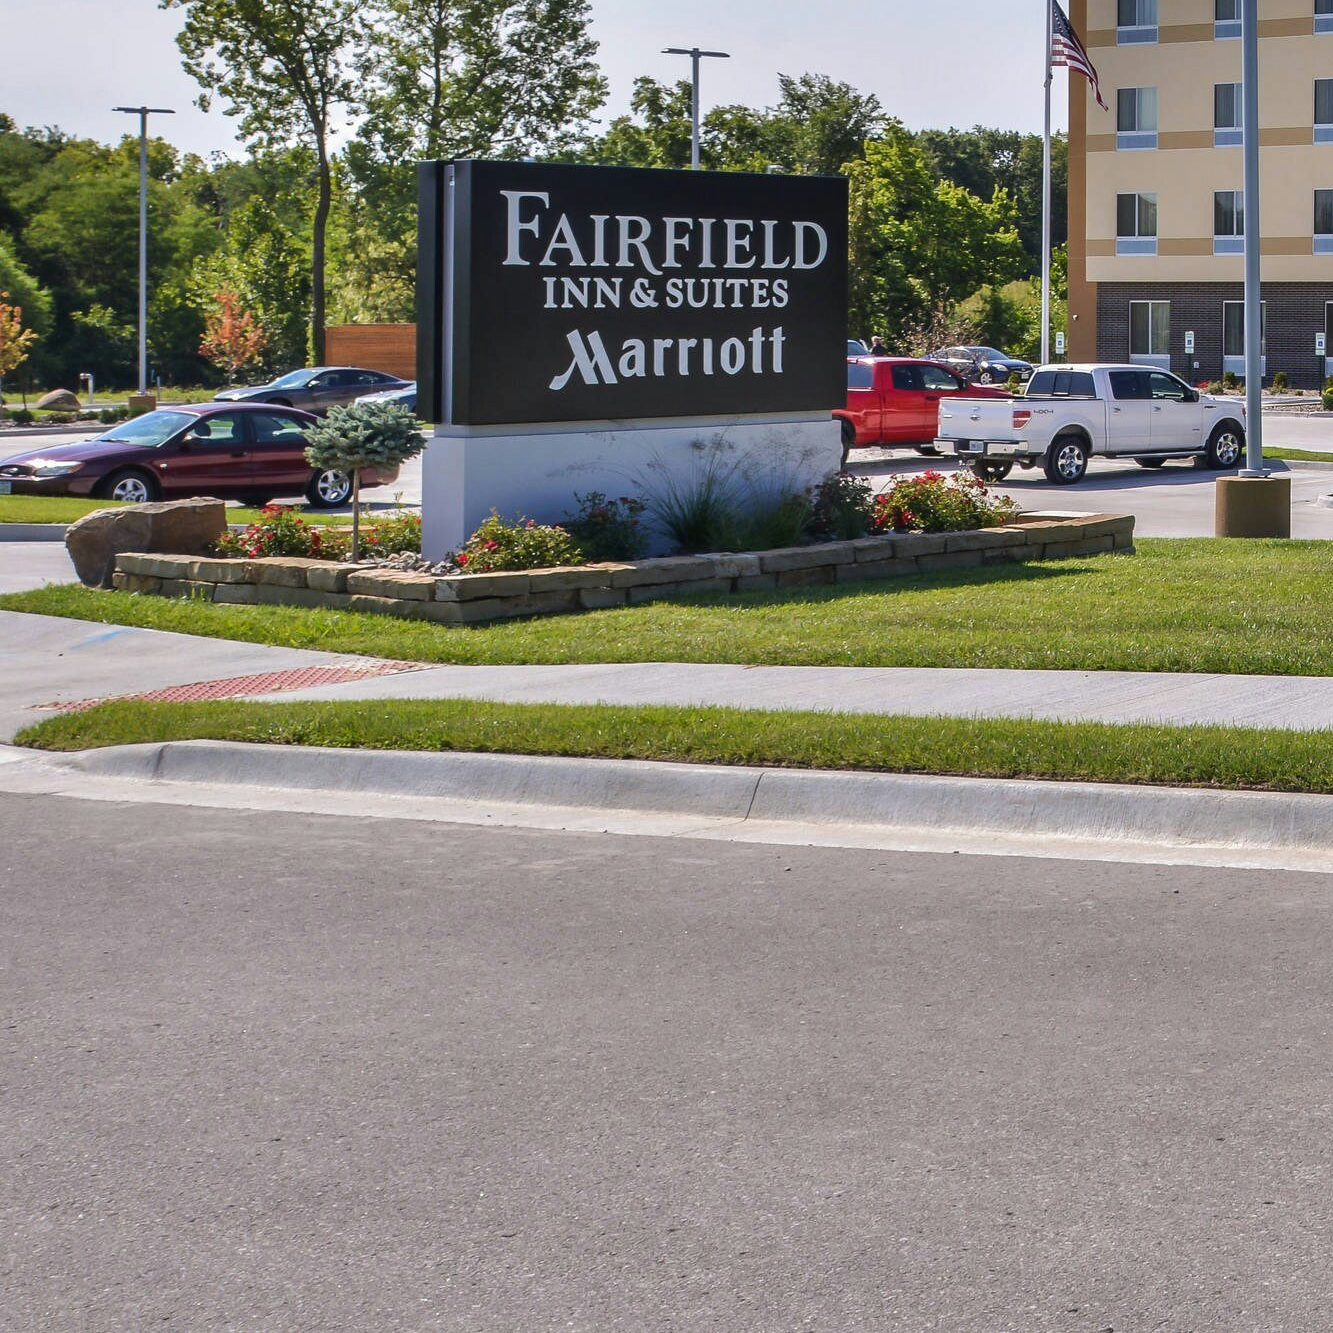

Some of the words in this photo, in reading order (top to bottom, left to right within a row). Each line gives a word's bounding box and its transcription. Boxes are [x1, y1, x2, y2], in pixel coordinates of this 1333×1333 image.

[500, 190, 828, 275] FAIRFIELD
[543, 277, 623, 308] INN
[630, 278, 659, 308] &
[666, 279, 789, 308] SUITES
[549, 326, 786, 391] Marriott
